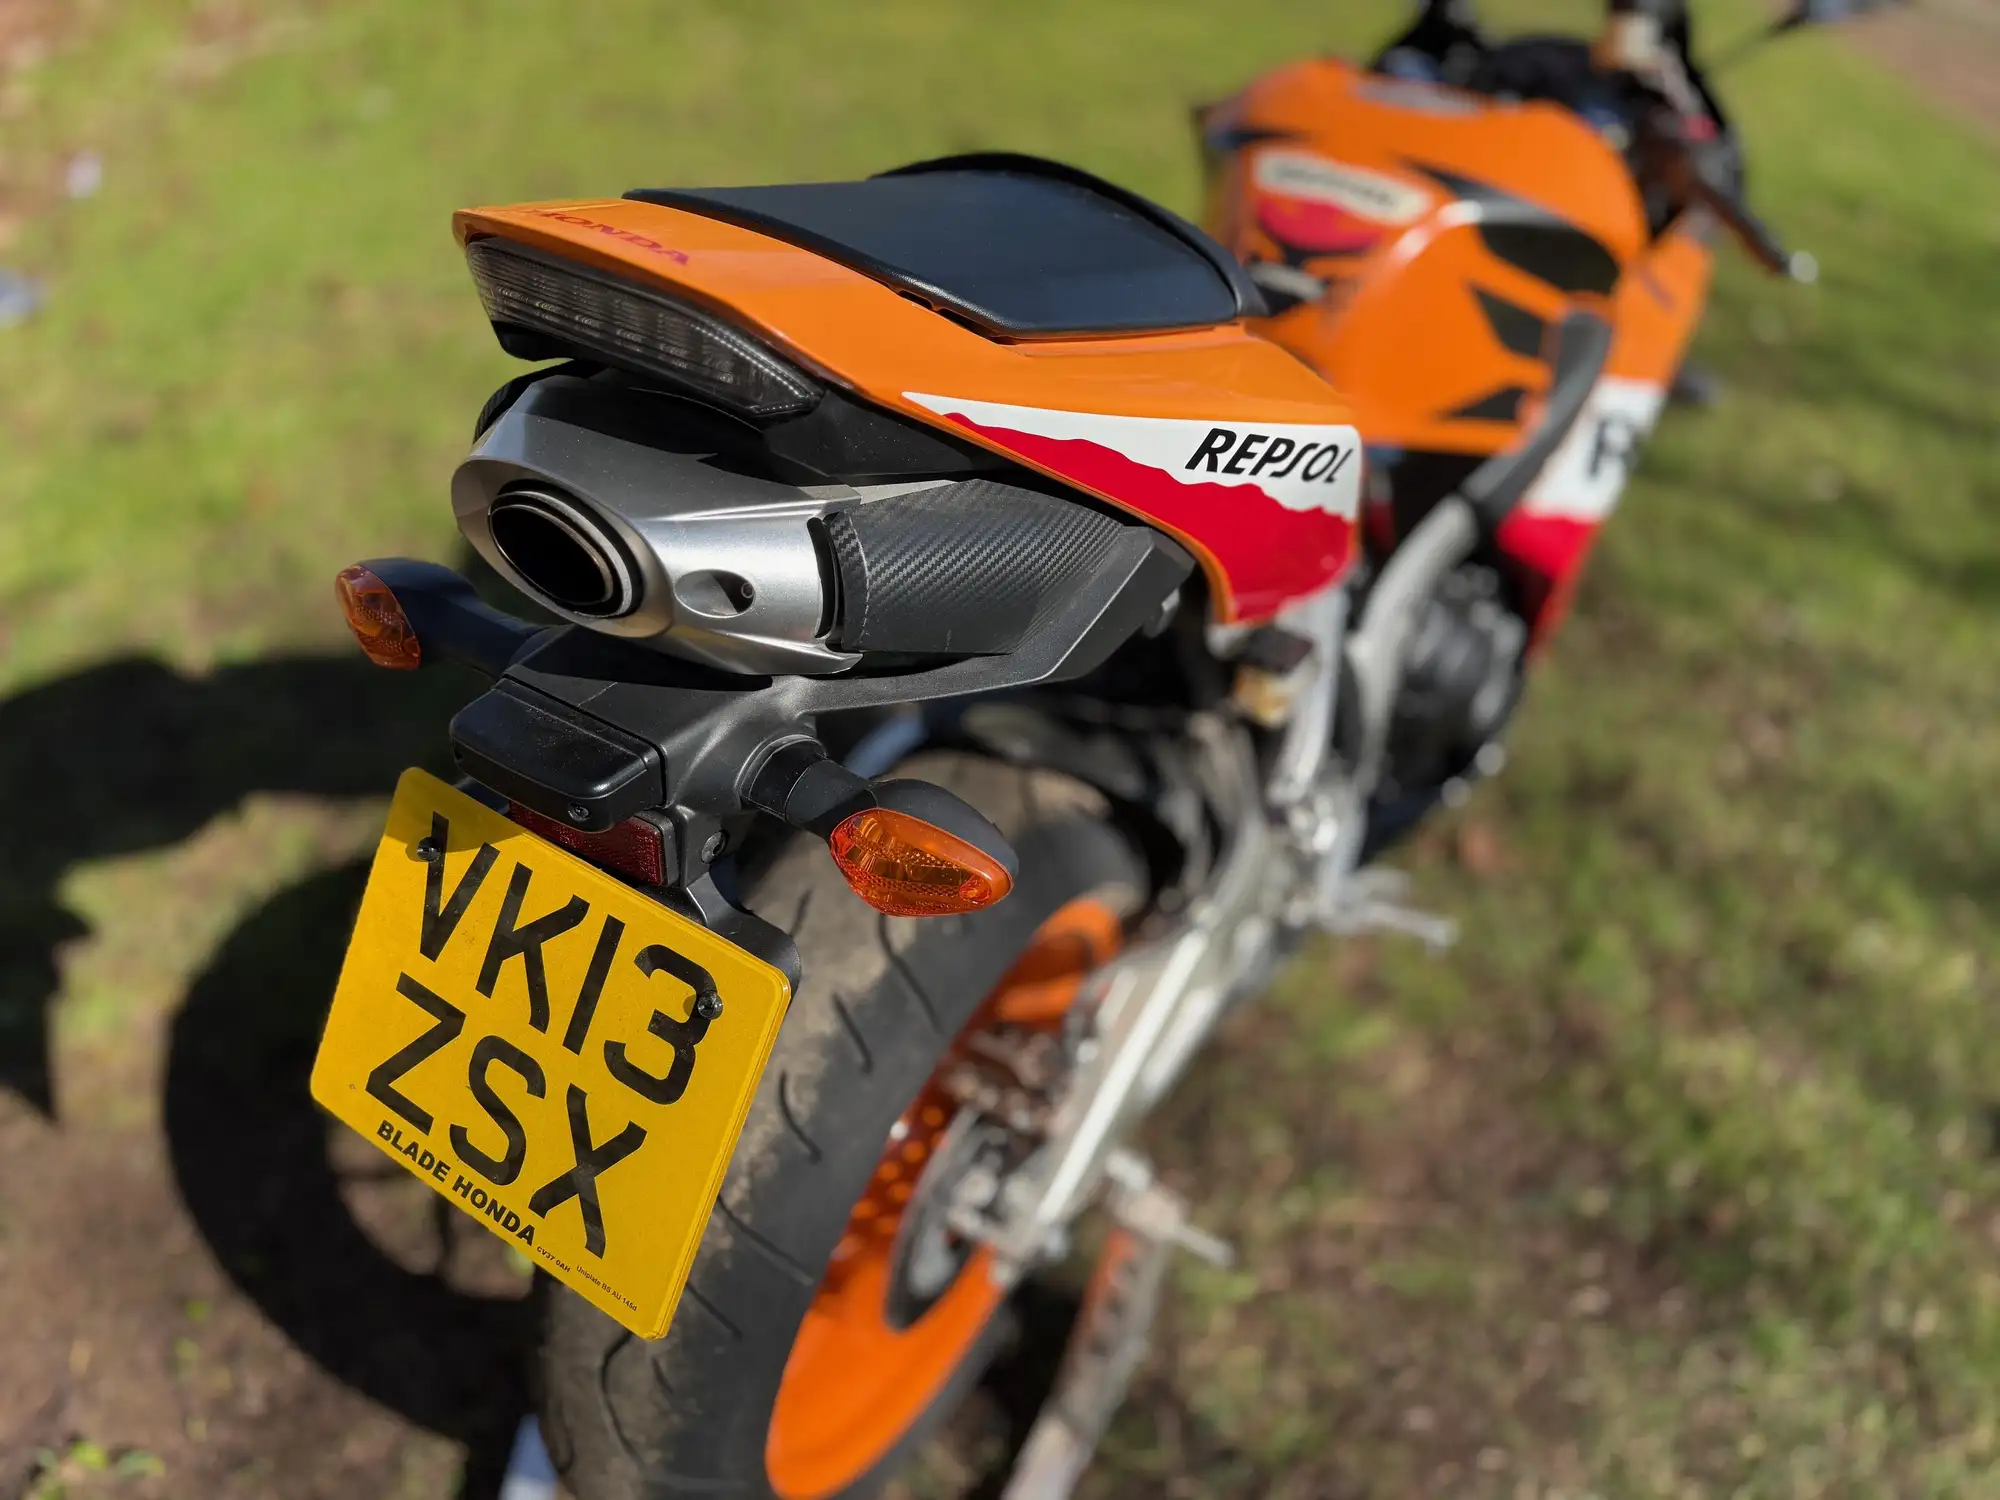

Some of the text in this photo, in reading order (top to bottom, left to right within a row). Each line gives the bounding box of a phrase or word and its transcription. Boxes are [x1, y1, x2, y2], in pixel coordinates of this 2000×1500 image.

[1184, 427, 1353, 484] REPSOL
[419, 811, 718, 1106] VK13
[365, 971, 647, 1259] ZSX
[376, 1119, 535, 1246] BLADE HONDA
[536, 1246, 555, 1261] CV37
[576, 1265, 637, 1312] Uniplate BS AU 145d
